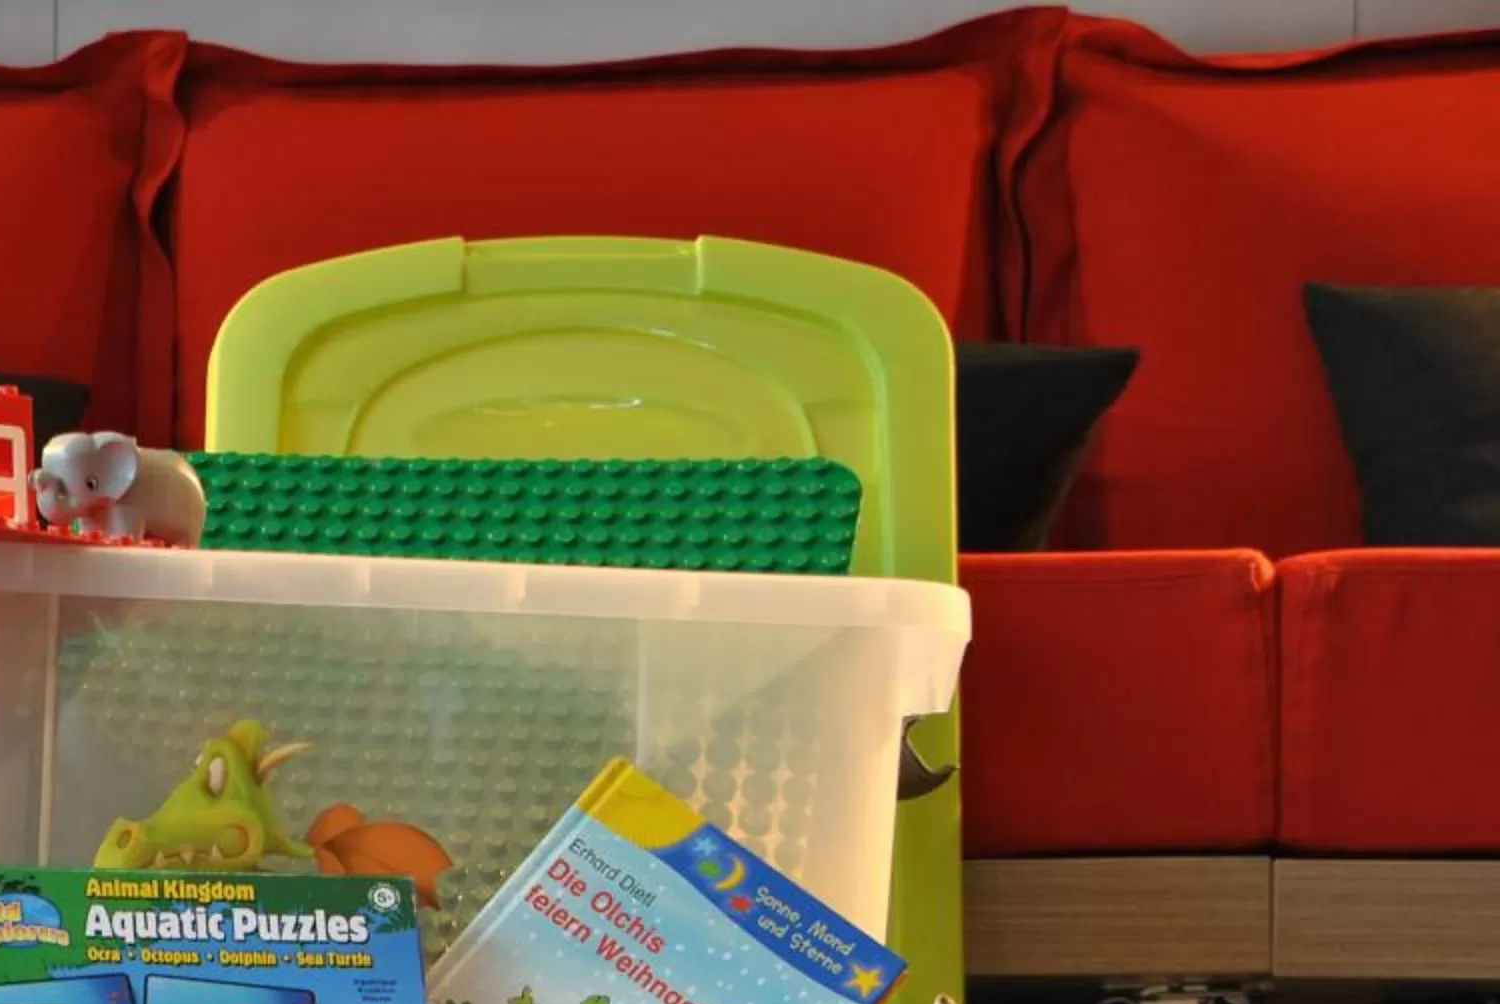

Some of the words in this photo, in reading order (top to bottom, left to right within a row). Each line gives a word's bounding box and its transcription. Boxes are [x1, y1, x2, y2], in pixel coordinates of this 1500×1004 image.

[568, 837, 620, 881] Erhard
[86, 878, 158, 898] Animal
[163, 880, 255, 903] Kingdom
[524, 883, 592, 943] feiern
[547, 856, 588, 897] Die
[590, 890, 666, 954] Olchis
[85, 904, 225, 943] Aquatic
[231, 908, 369, 943] Puzzles
[756, 886, 803, 928] Sonne,
[806, 920, 856, 956] Mond
[757, 914, 790, 938] und
[789, 932, 843, 975] Sterne
[141, 948, 199, 965] Octopus
[219, 948, 277, 967] Dolphin
[297, 951, 324, 966] Sea
[327, 951, 372, 967] Turtle
